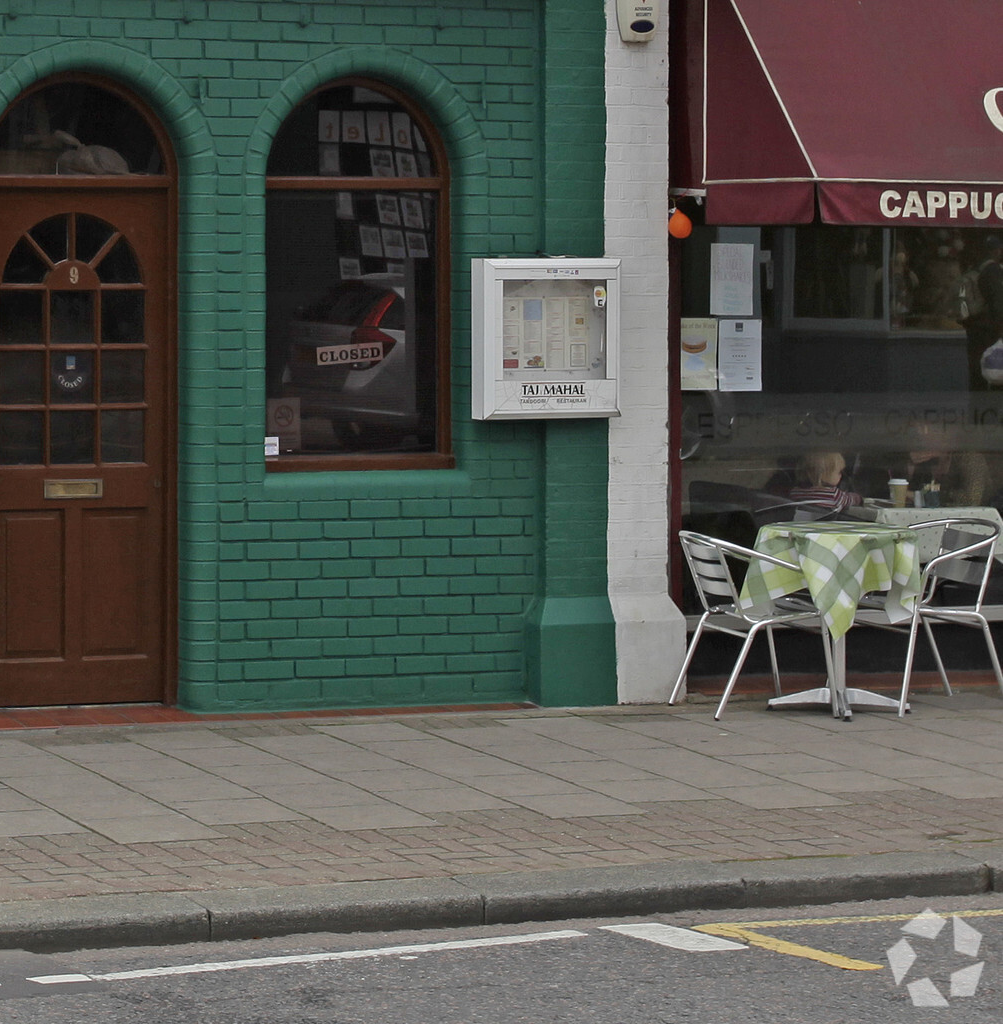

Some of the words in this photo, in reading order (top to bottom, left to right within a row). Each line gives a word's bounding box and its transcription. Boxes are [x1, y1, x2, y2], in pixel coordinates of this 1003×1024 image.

[69, 266, 79, 284] 9
[319, 347, 381, 363] CLOSED
[58, 375, 83, 389] CLOSED
[521, 384, 539, 395] TAJ
[543, 384, 586, 395] MAHAL
